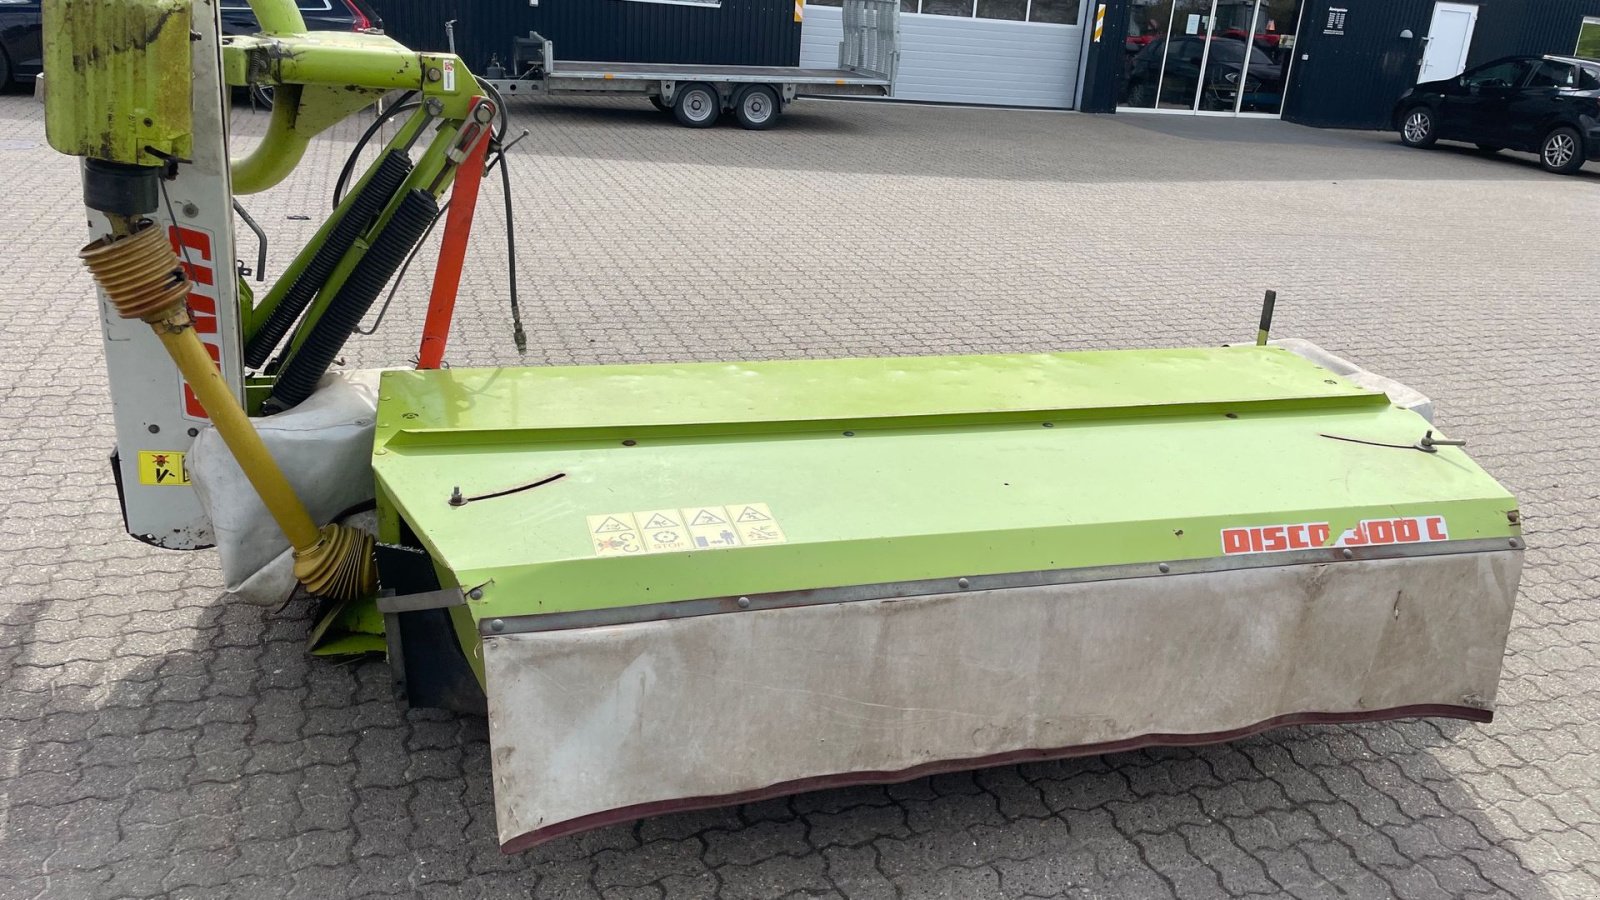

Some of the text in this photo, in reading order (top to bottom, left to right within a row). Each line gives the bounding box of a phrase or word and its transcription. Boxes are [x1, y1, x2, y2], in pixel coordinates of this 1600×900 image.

[653, 541, 684, 550] STOP
[1223, 524, 1330, 554] DISCO
[1426, 517, 1447, 541] C
